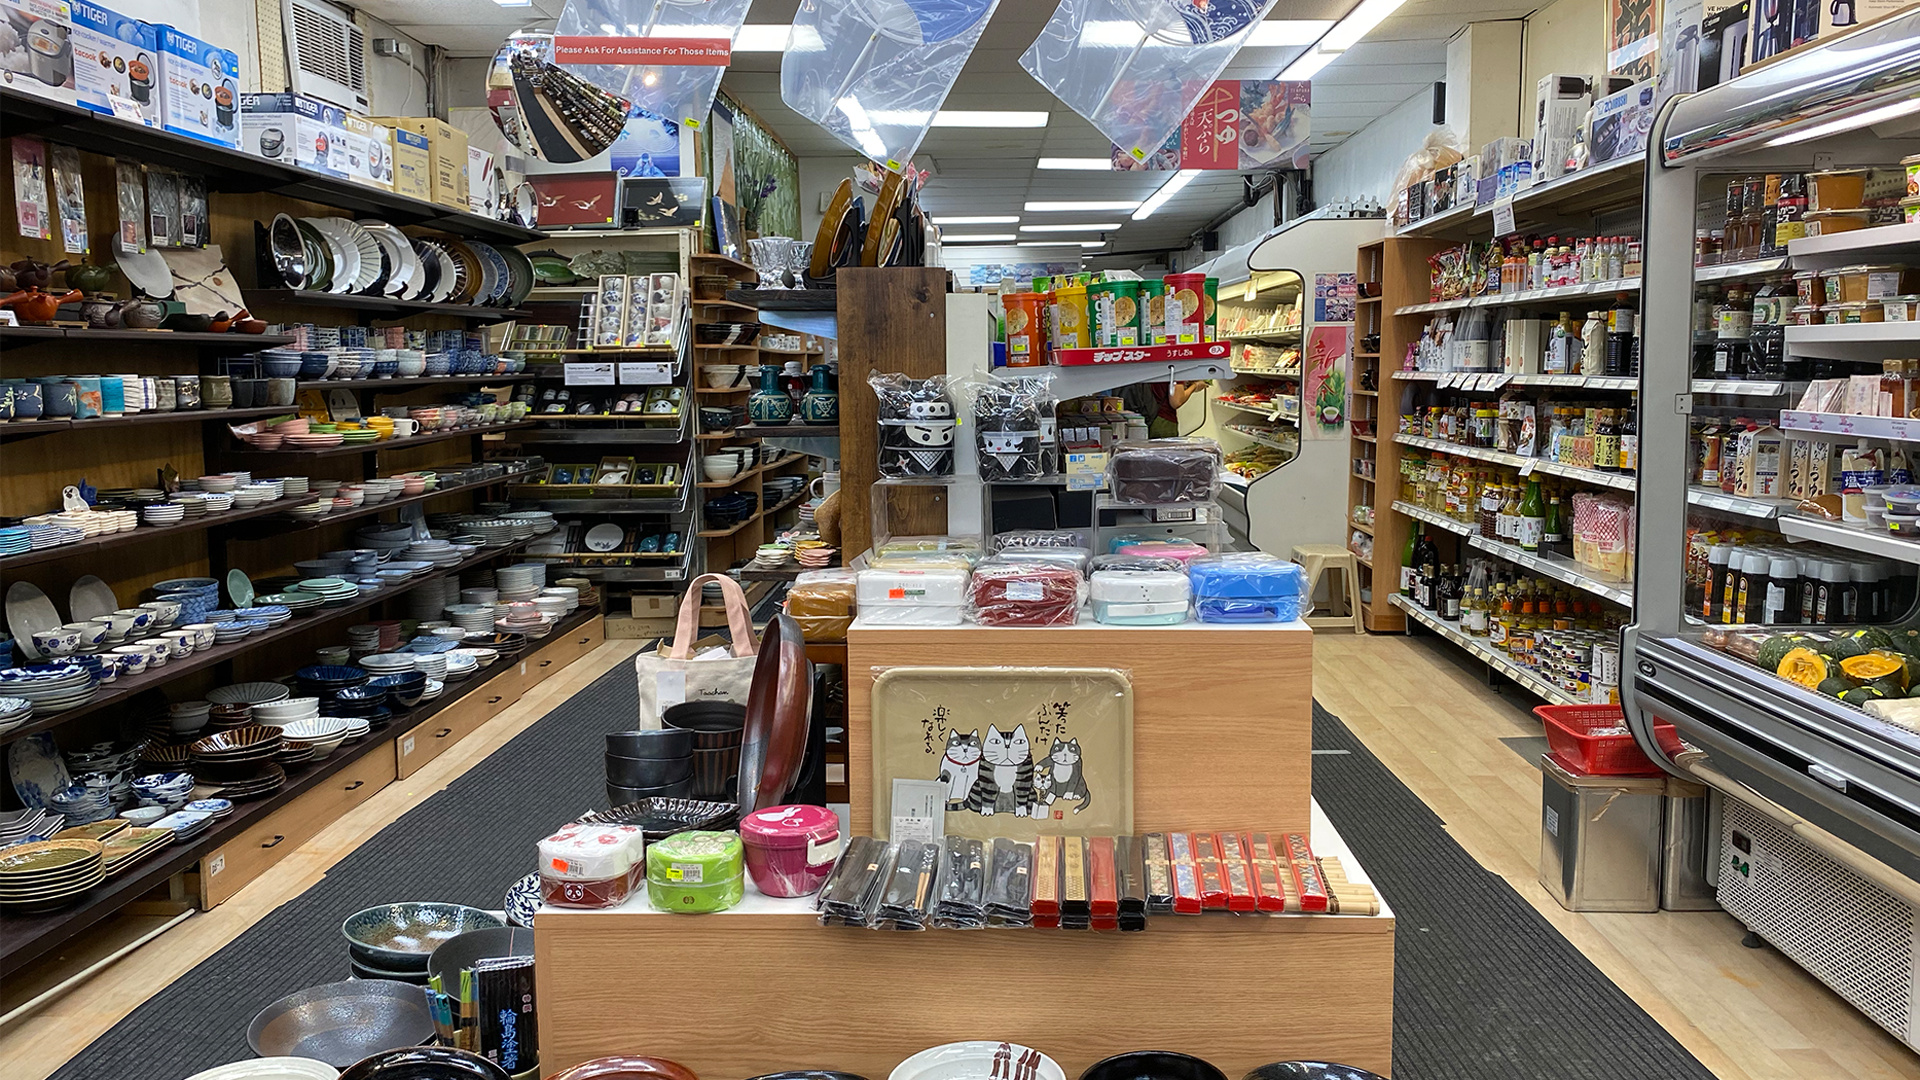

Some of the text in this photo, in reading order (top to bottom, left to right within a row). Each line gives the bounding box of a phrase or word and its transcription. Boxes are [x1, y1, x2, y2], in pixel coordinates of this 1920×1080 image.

[80, 3, 108, 26] TIGER
[74, 47, 97, 62] tacook
[174, 34, 198, 55] TIGER
[556, 46, 582, 54] Please
[584, 46, 599, 54] Ask
[617, 47, 661, 55] Assistance
[663, 47, 677, 55] For
[679, 47, 704, 55] Those
[706, 48, 729, 57] Items
[1196, 108, 1214, 155] 天ぷら
[1215, 109, 1239, 145] つゆ
[1093, 349, 1151, 363] チップスター
[1308, 340, 1339, 402] 新茶
[932, 704, 950, 742] 楽しく
[1035, 702, 1053, 745] ぶんだけ
[1053, 701, 1071, 734] 笑った
[499, 1008, 518, 1069] 輪島塗箸
